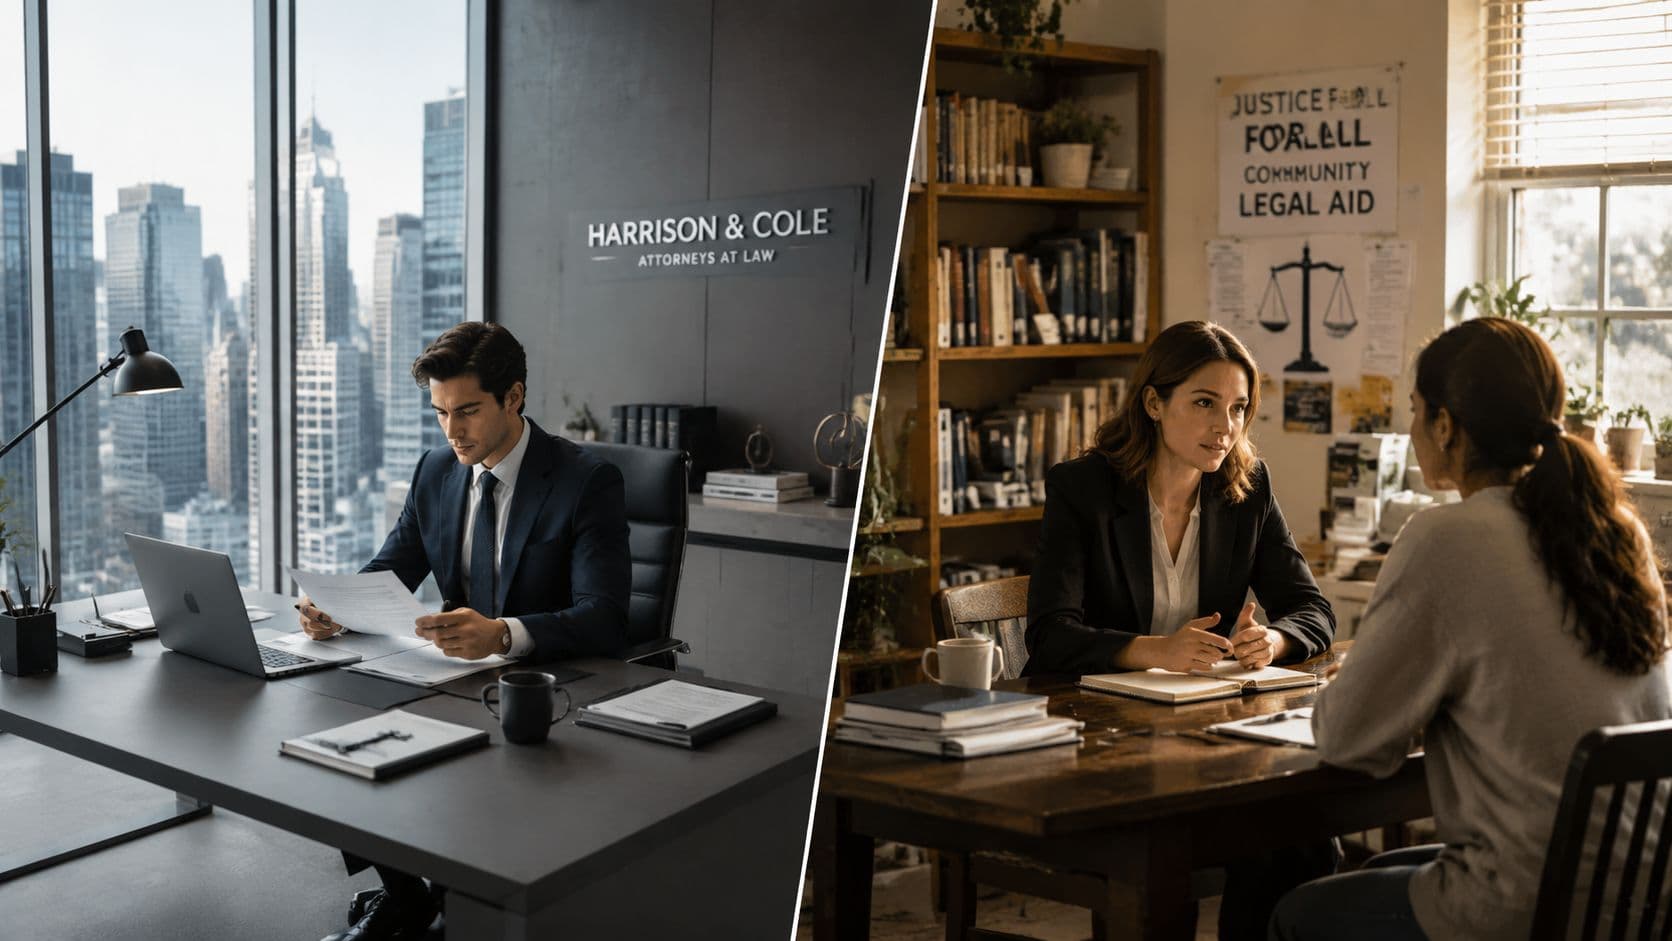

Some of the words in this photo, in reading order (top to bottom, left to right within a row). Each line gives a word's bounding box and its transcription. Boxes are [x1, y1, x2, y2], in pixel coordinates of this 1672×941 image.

[1231, 88, 1323, 118] JUSTICE
[1239, 191, 1320, 218] LEGAL
[1328, 190, 1376, 215] AID
[588, 215, 718, 247] HARRISON
[724, 213, 745, 240] &
[752, 207, 829, 238] COLE
[638, 251, 716, 267] ATTORNEYS
[720, 250, 738, 265] AT
[743, 249, 776, 263] LAW
